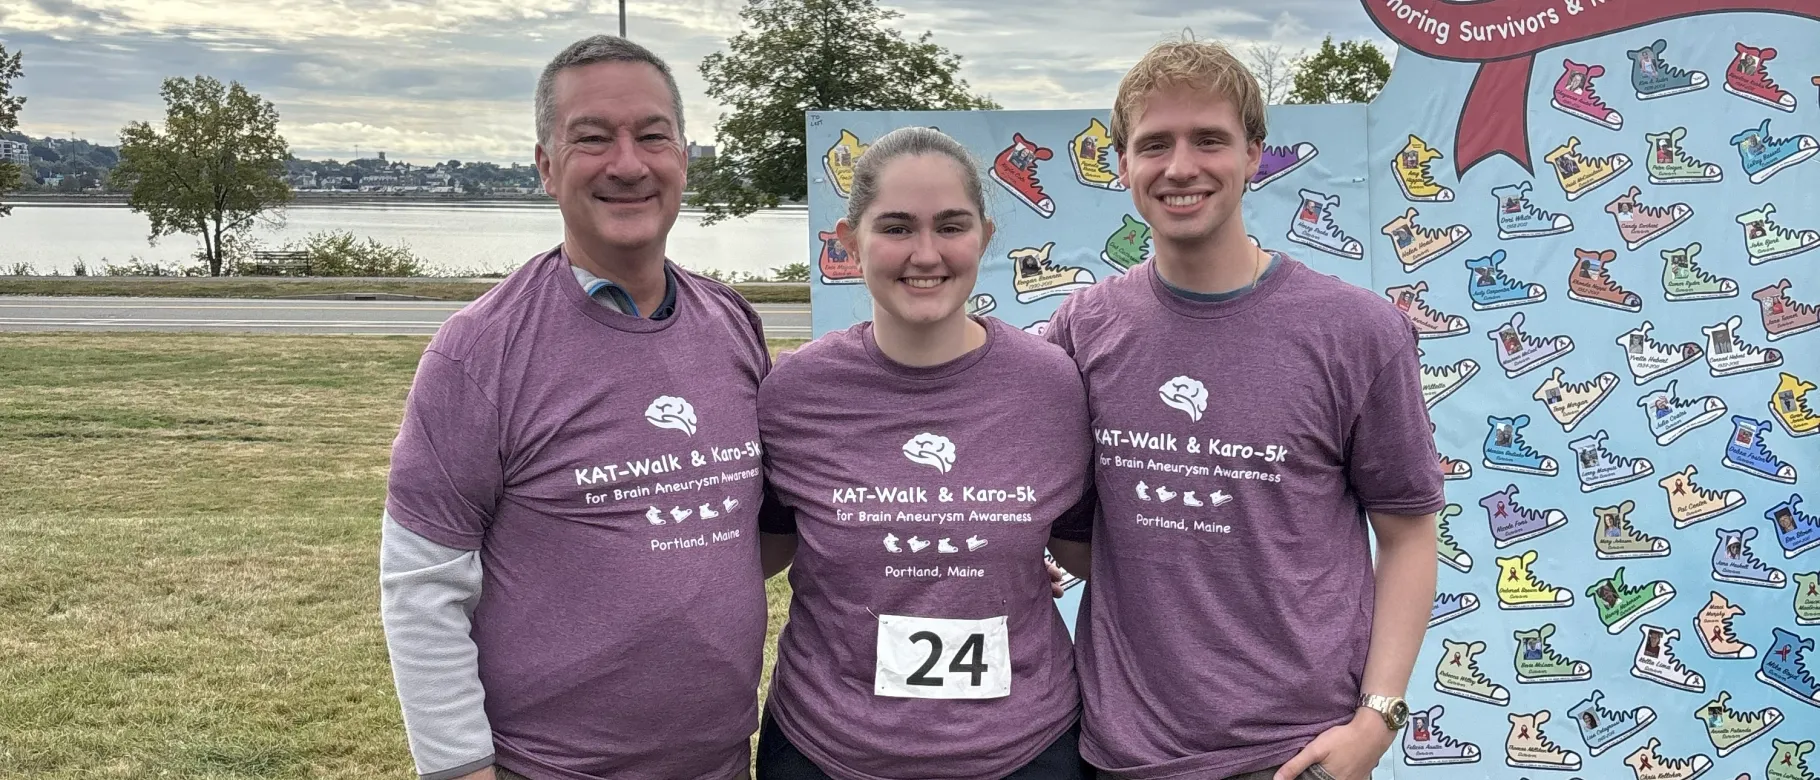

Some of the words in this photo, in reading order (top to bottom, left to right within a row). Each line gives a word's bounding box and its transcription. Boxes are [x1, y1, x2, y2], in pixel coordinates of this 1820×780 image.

[1459, 7, 1559, 42] Survivors
[1094, 428, 1177, 451] KAT-Walk
[1186, 436, 1200, 453] &
[1208, 438, 1288, 462] Karo-5k
[574, 454, 682, 486] KAT-Walk
[690, 450, 706, 467] &
[711, 440, 761, 463] Karo-5k
[1100, 452, 1111, 466] for
[1115, 455, 1144, 469] Brain
[1147, 458, 1209, 476] Aneurysm
[1214, 465, 1281, 482] Awareness
[586, 492, 608, 504] for
[614, 486, 650, 500] Brain
[654, 475, 720, 494] Aneurysm
[832, 486, 928, 504] KAT-Walk
[938, 486, 954, 502] &
[962, 486, 1036, 502] Karo-5k
[836, 510, 853, 522] for
[858, 510, 892, 522] Brain
[896, 510, 964, 524] Aneurysm
[968, 510, 1032, 522] Awareness
[1136, 514, 1188, 531] Portland,
[1194, 520, 1231, 534] Maine
[650, 536, 708, 551] Portland,
[712, 528, 740, 542] Maine
[885, 566, 942, 578] Portland,
[947, 566, 984, 577] Maine
[906, 630, 988, 686] 24
